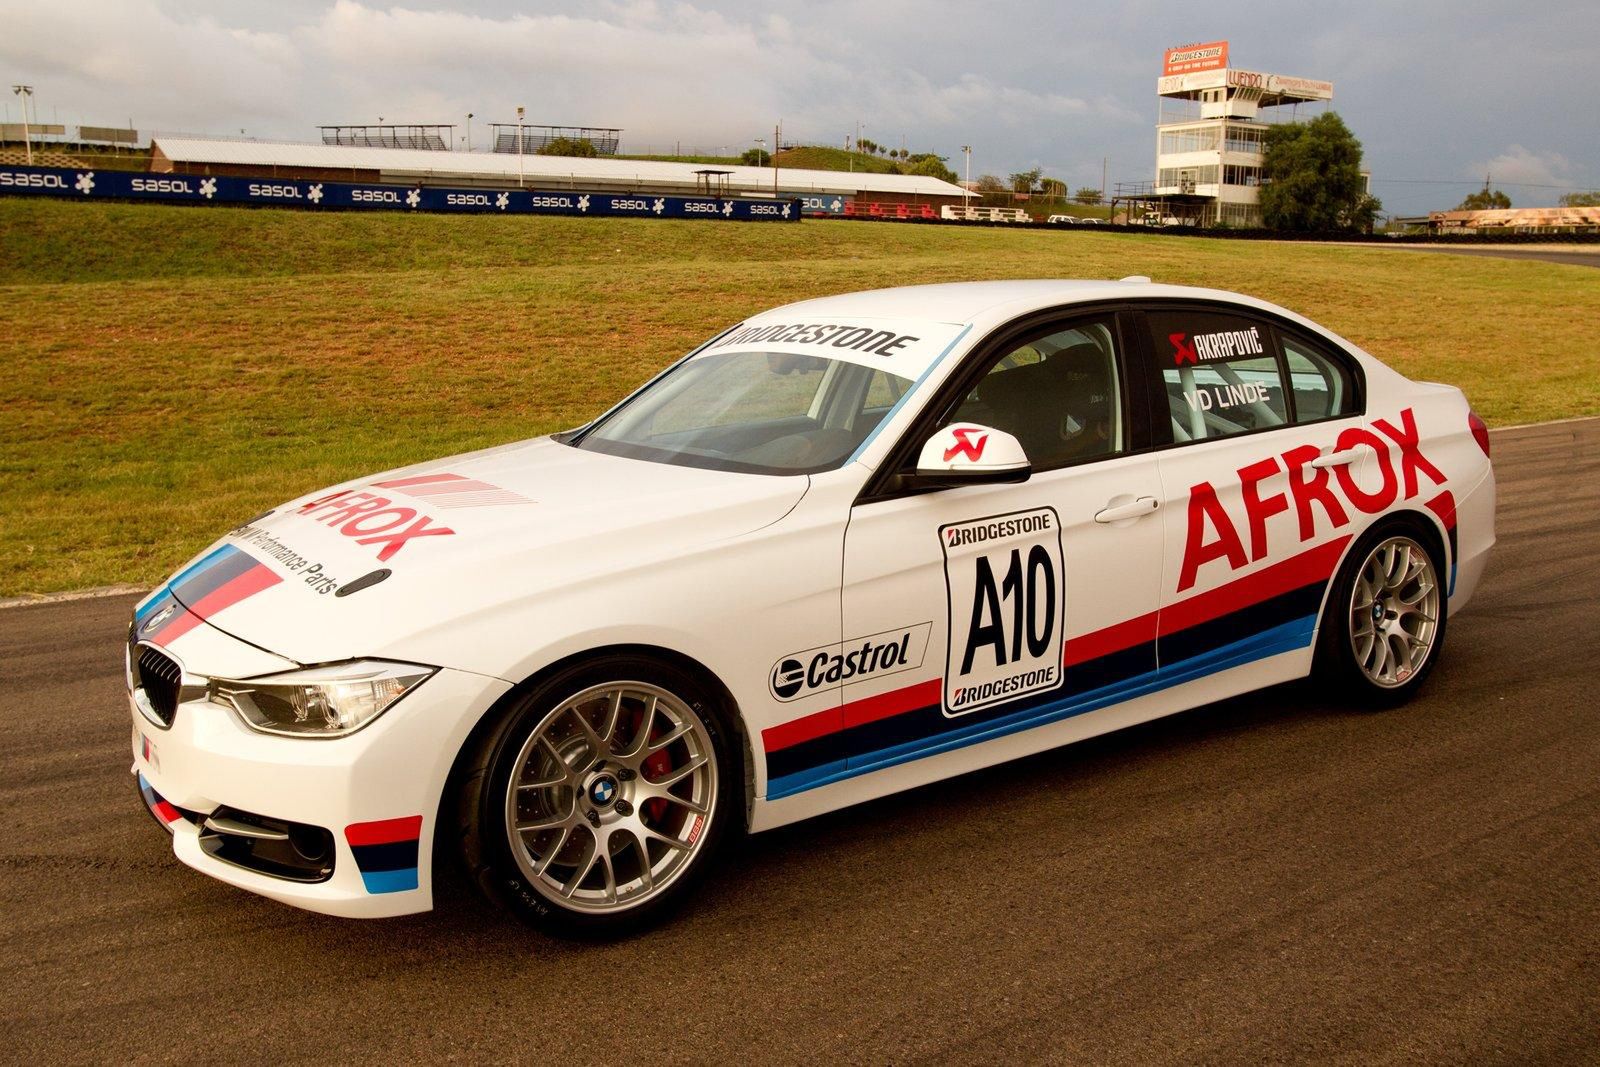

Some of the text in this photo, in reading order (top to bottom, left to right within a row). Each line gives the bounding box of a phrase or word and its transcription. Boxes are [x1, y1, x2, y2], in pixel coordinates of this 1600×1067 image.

[1170, 48, 1220, 63] BRIDGESTONE
[1228, 71, 1262, 88] LUENDO
[801, 197, 827, 209] SOL
[1183, 380, 1270, 412] VD LINDE
[1176, 407, 1448, 594] AFROX
[290, 490, 456, 562] AFROX
[947, 513, 1051, 548] BRIDGESTONE
[248, 531, 308, 571] Performance
[297, 563, 338, 595] Parts
[960, 544, 1056, 676] A10
[806, 632, 911, 688] Castrol
[952, 665, 1055, 708] BRIDGESTONE
